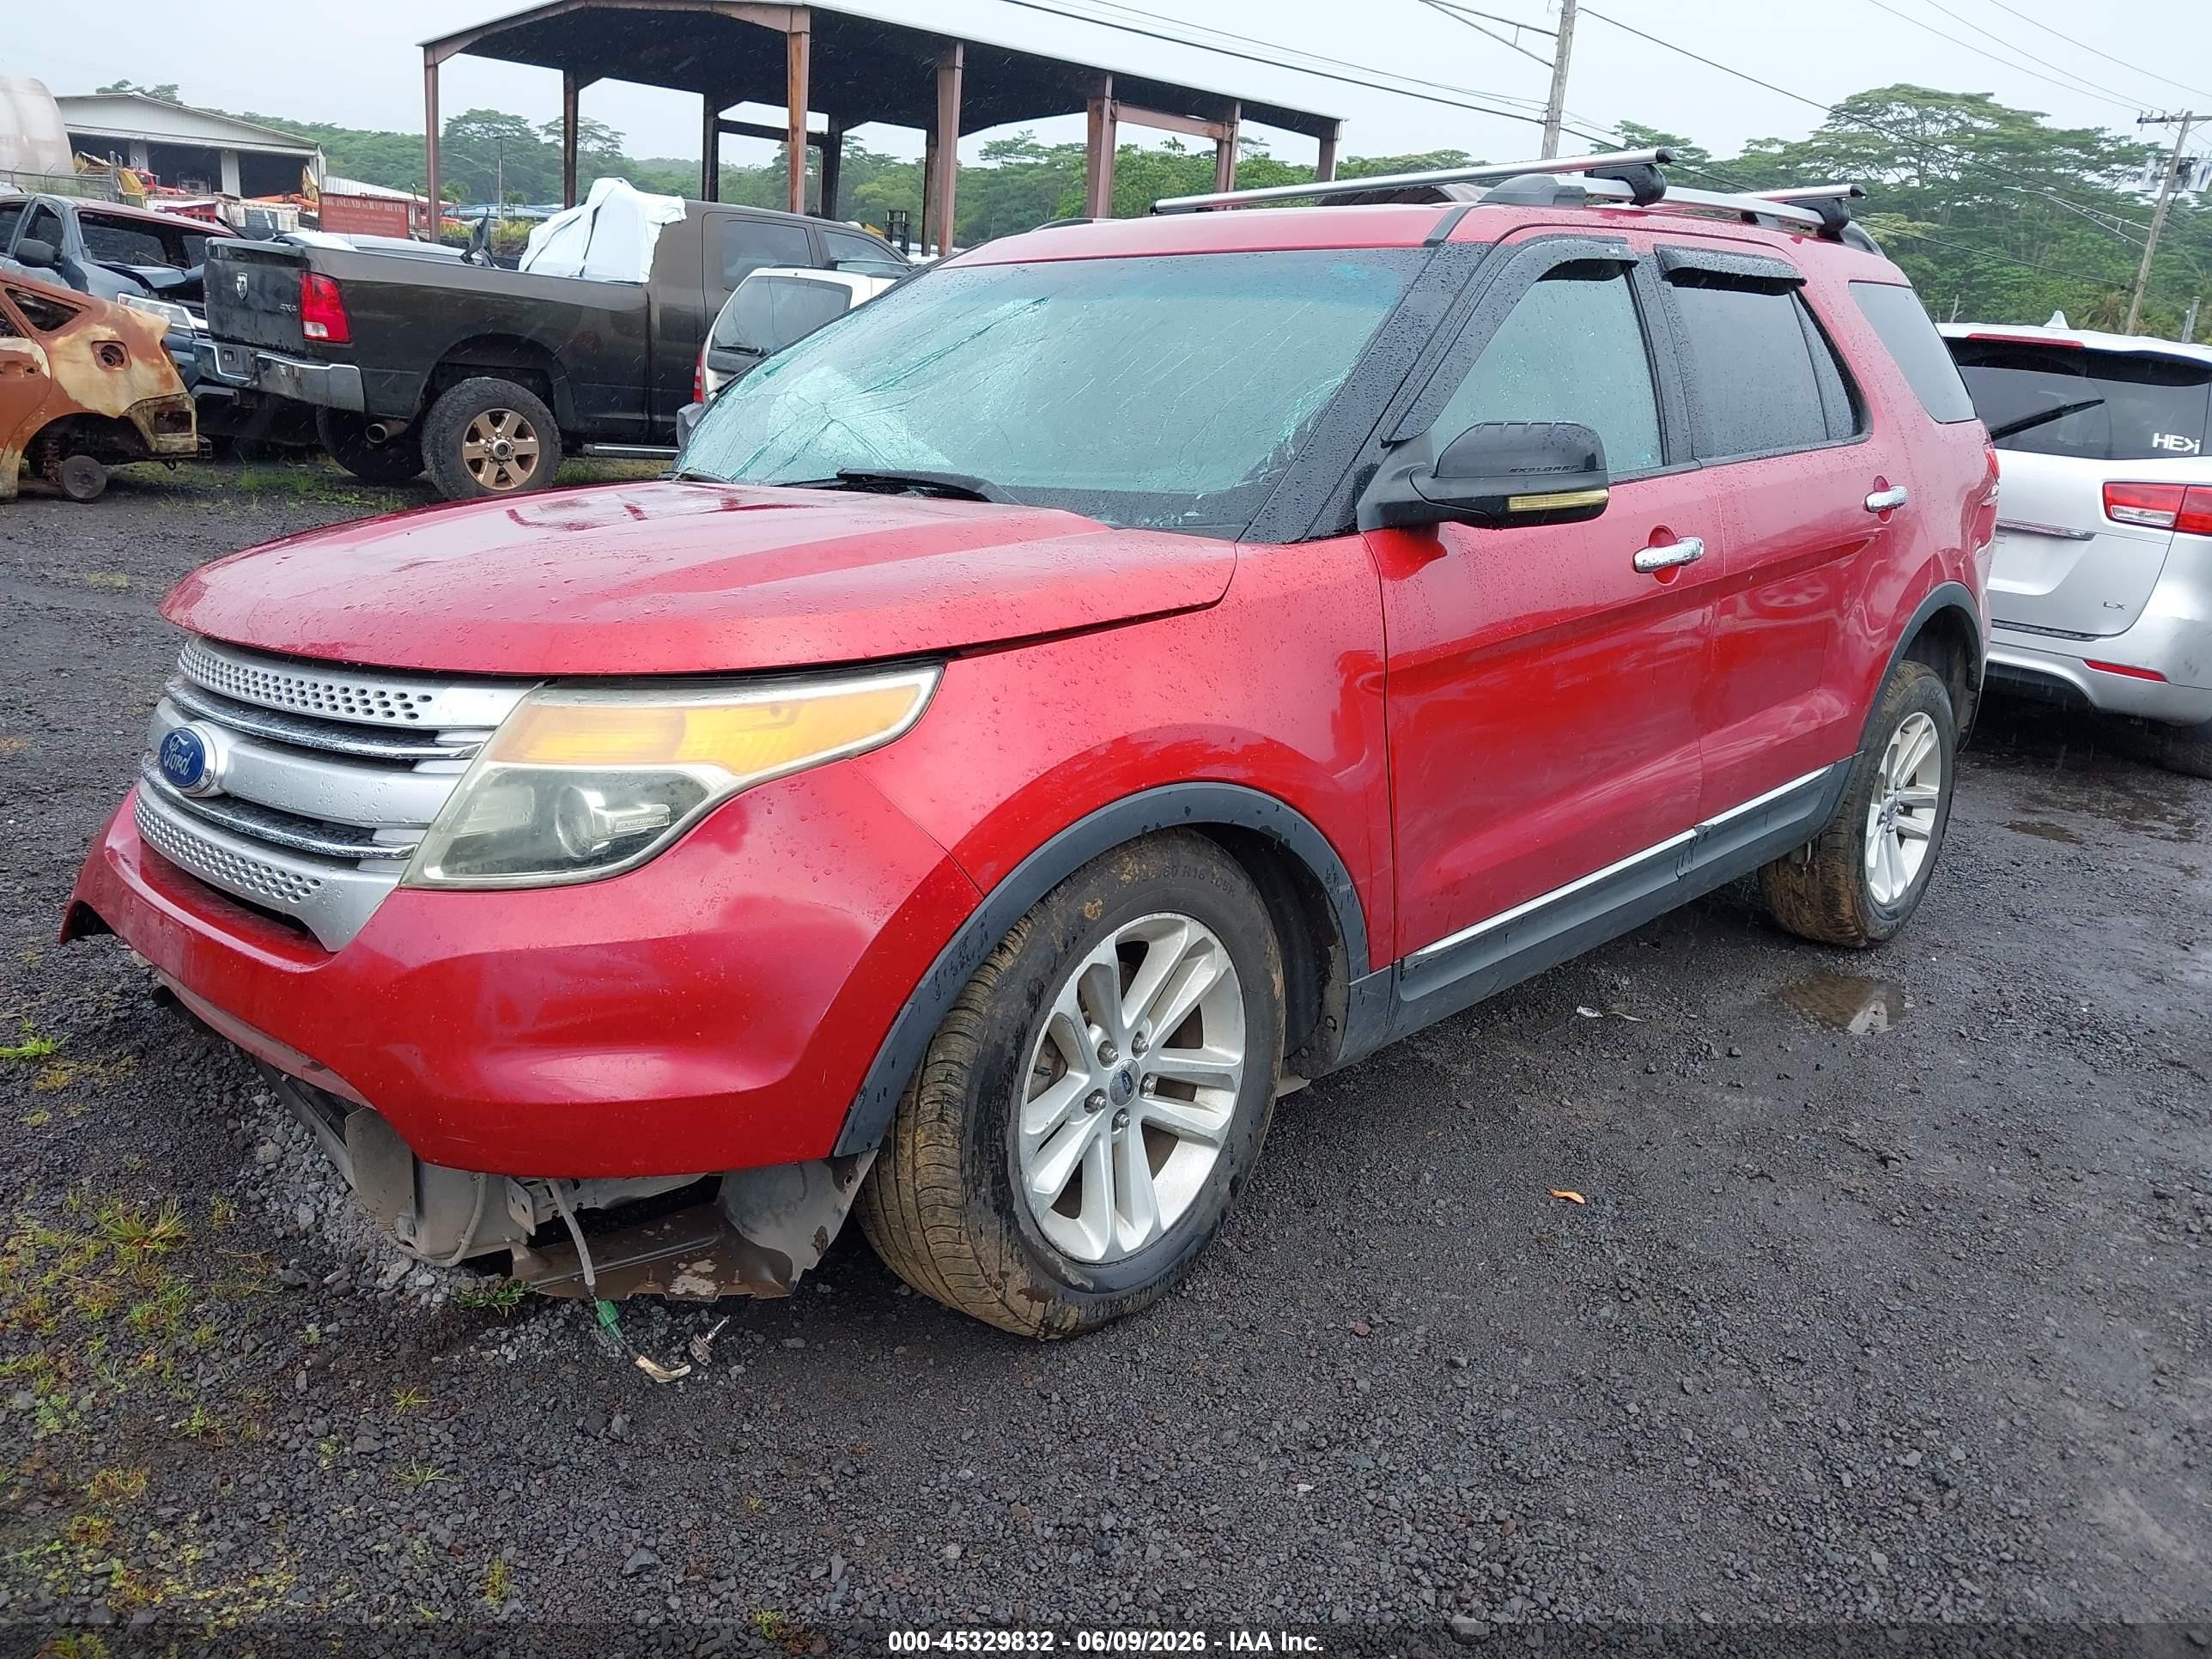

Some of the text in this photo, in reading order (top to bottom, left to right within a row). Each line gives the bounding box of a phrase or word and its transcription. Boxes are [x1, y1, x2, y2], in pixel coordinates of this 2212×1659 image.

[323, 197, 336, 206] BIG
[337, 198, 361, 209] ISLAND
[1509, 465, 1580, 473] EXPLORER
[2103, 601, 2127, 611] LX
[164, 734, 194, 776] Ford
